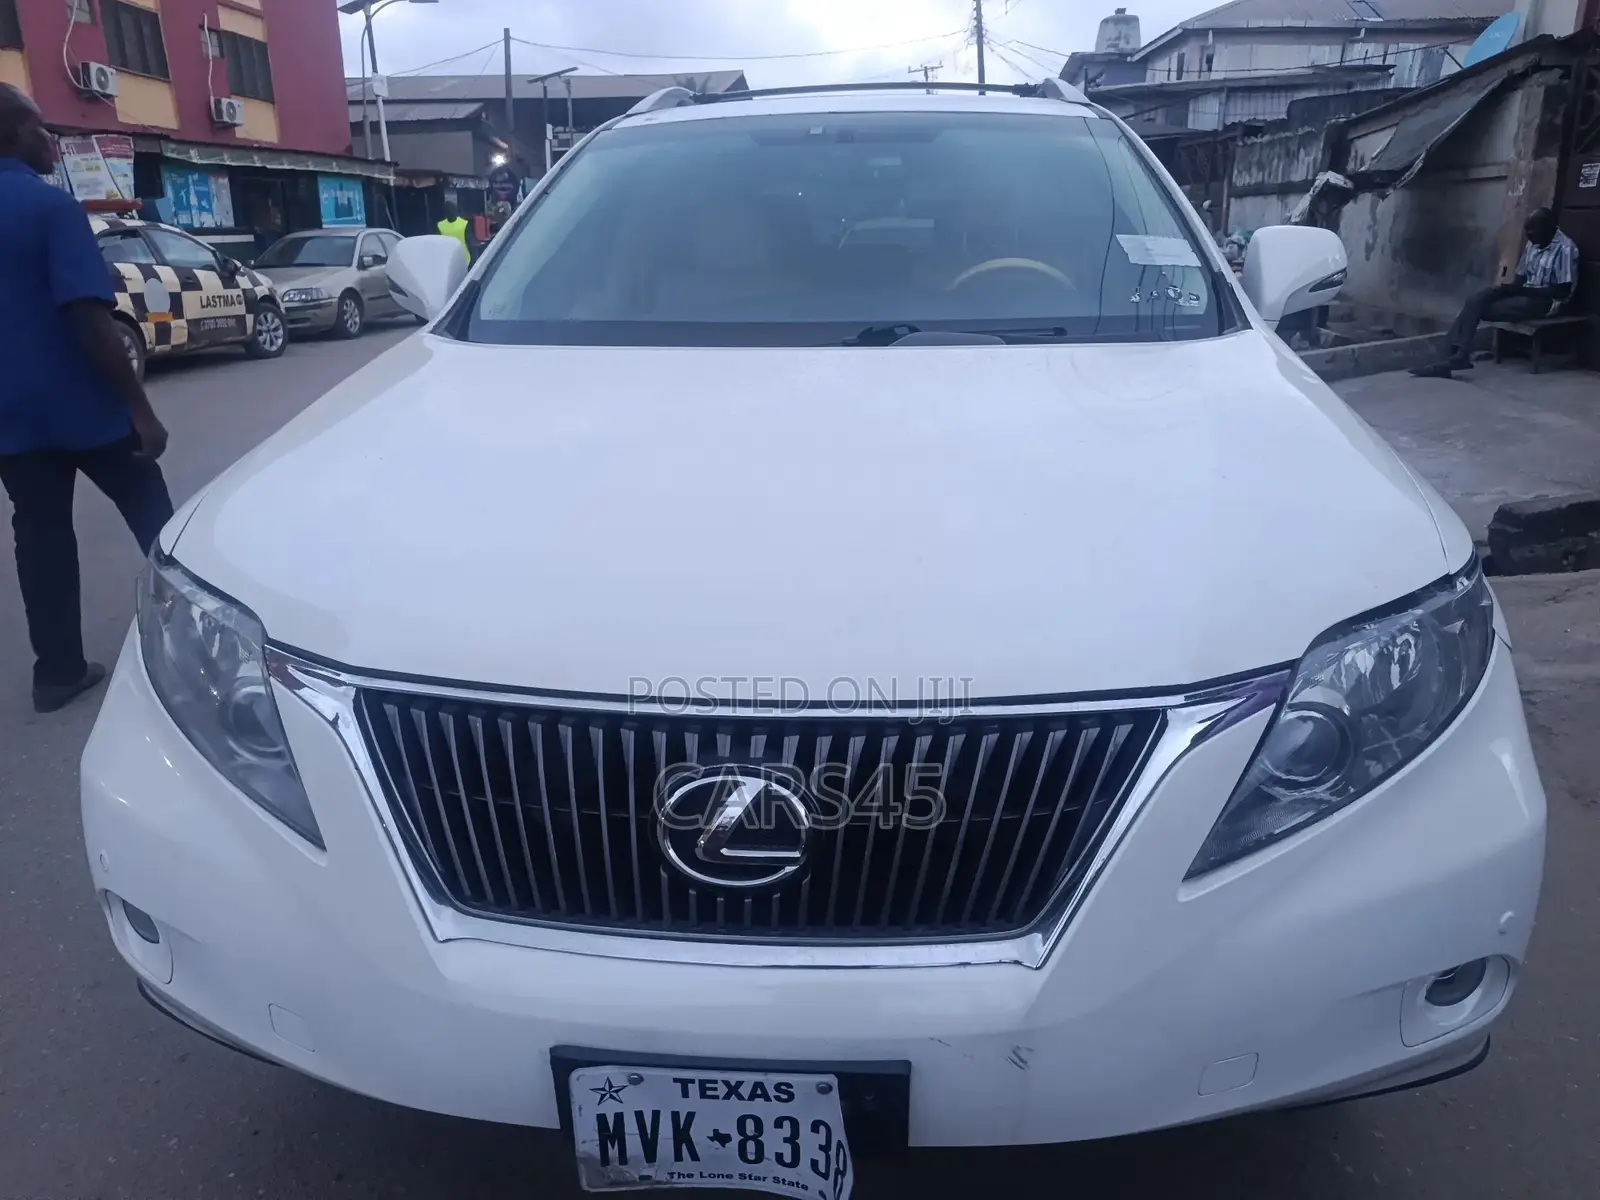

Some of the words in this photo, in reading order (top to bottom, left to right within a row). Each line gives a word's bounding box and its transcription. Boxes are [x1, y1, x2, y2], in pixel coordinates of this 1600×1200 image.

[200, 294, 236, 309] LASTMA
[672, 1077, 796, 1103] TEXAS
[596, 1109, 701, 1168] MVK
[667, 1171, 695, 1180] The
[699, 1171, 734, 1180] Lone
[738, 1172, 768, 1182] Star
[772, 1176, 809, 1191] State
